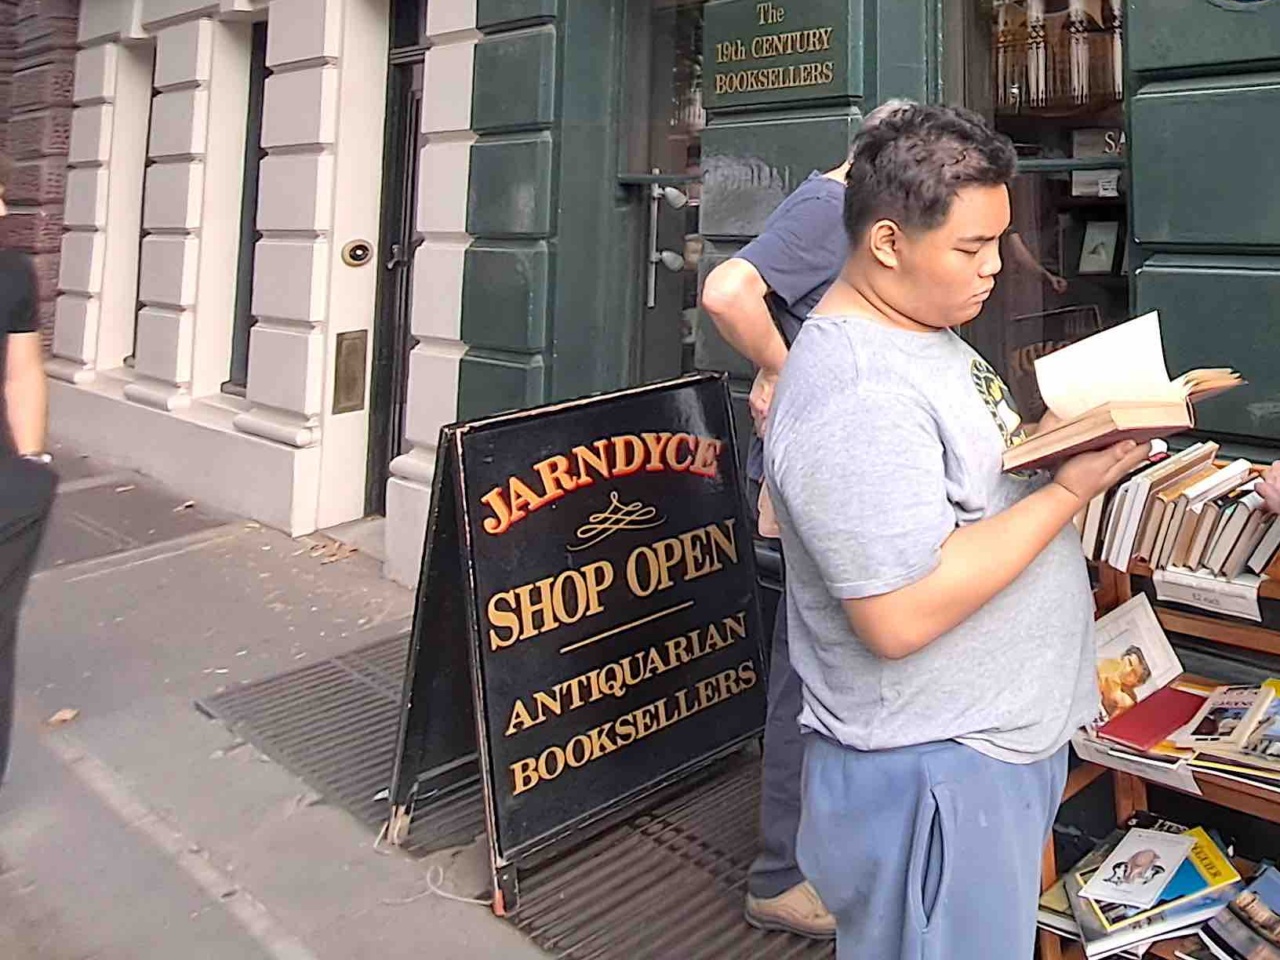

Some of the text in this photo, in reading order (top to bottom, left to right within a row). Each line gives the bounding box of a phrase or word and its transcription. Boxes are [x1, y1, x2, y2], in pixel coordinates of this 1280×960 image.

[751, 27, 833, 57] CENTURY
[757, 2, 784, 25] The
[715, 62, 834, 94] BOOKSELLERS
[480, 433, 722, 534] JARNDYCE
[487, 519, 740, 650] SHOP OPEN
[504, 612, 747, 736] ANTIQUARIAN
[510, 659, 758, 796] BOOKSELLERS
